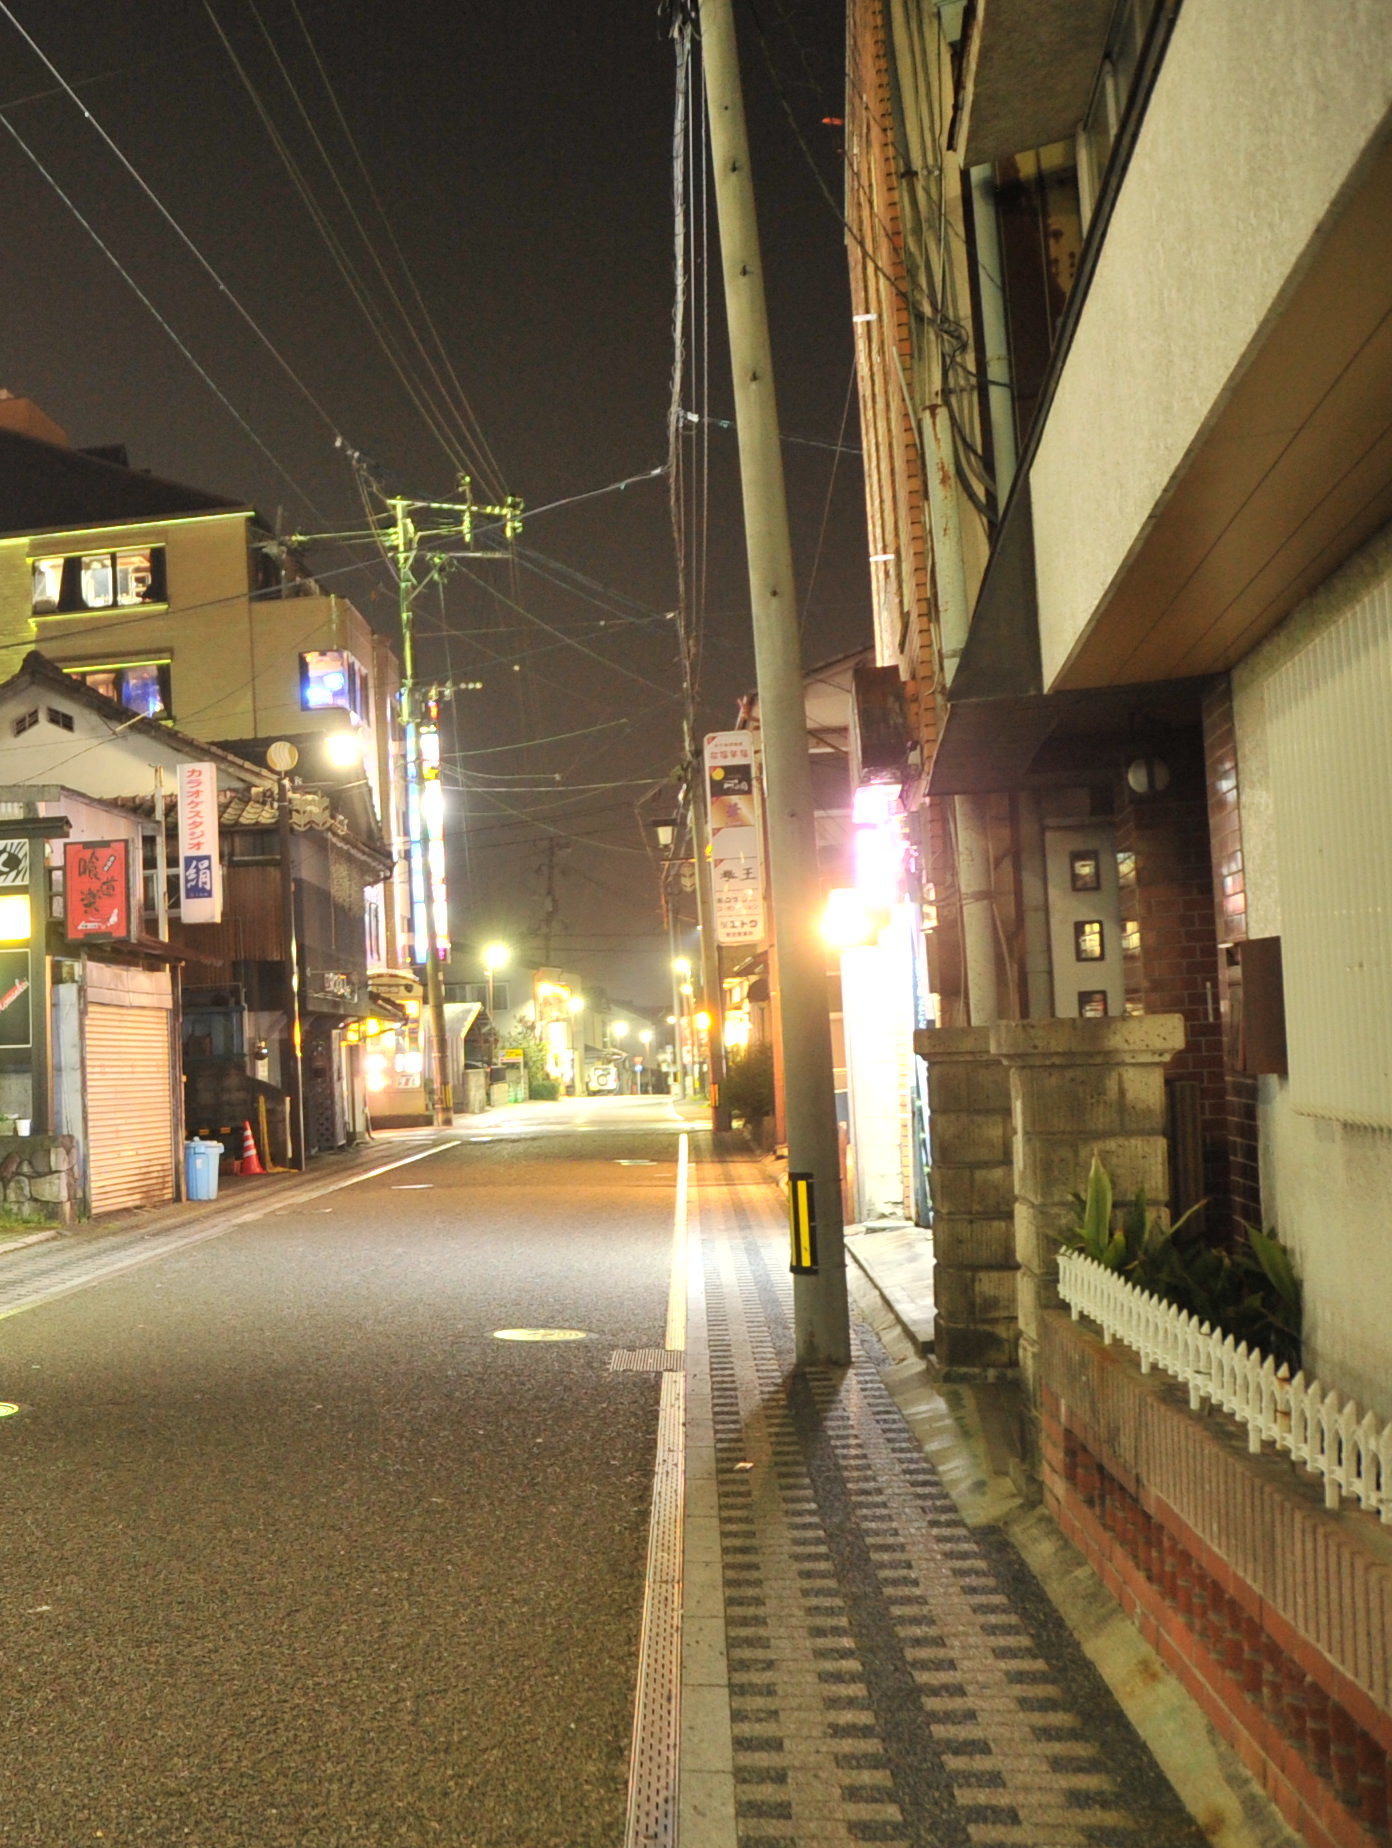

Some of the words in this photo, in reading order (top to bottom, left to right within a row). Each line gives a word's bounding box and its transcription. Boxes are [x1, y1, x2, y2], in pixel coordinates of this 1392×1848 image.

[186, 767, 206, 851] カラオケスタジオ
[185, 859, 211, 891] 絹
